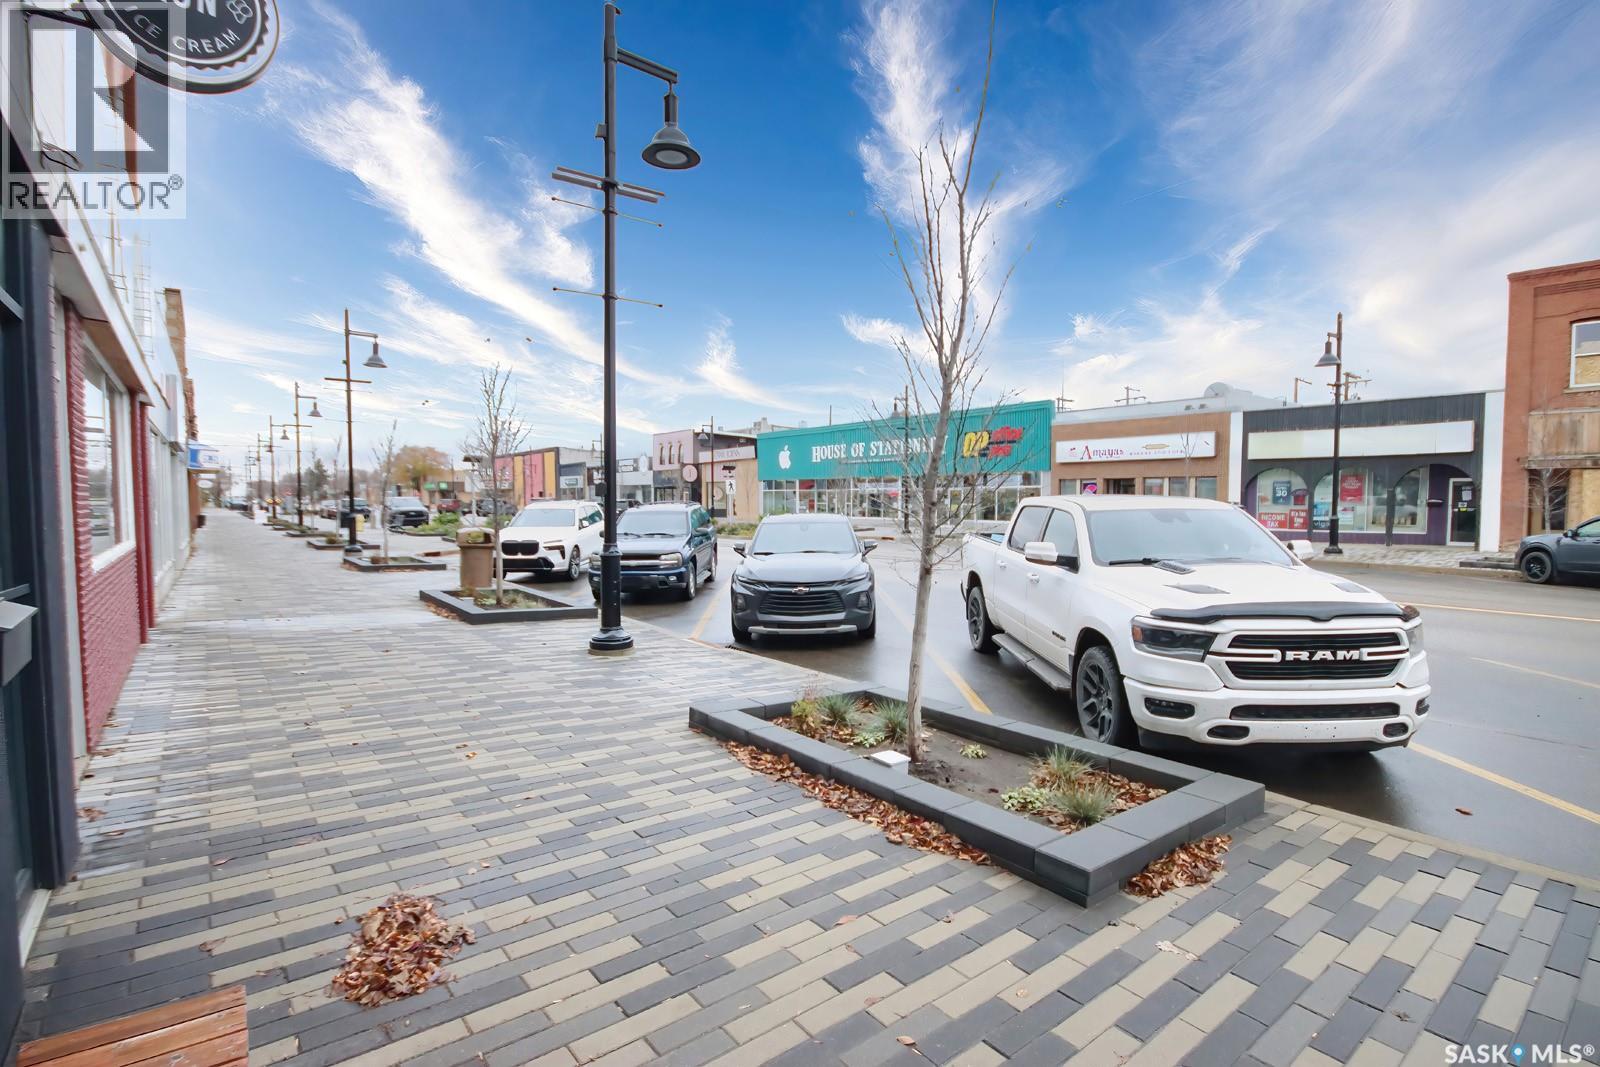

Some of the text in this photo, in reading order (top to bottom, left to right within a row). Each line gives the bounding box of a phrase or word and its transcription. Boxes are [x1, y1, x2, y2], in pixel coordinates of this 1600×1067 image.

[172, 28, 240, 54] CREAM
[812, 435, 949, 462] HOUSE OF STATION
[1267, 520, 1280, 528] TAX
[1285, 650, 1361, 661] RAM
